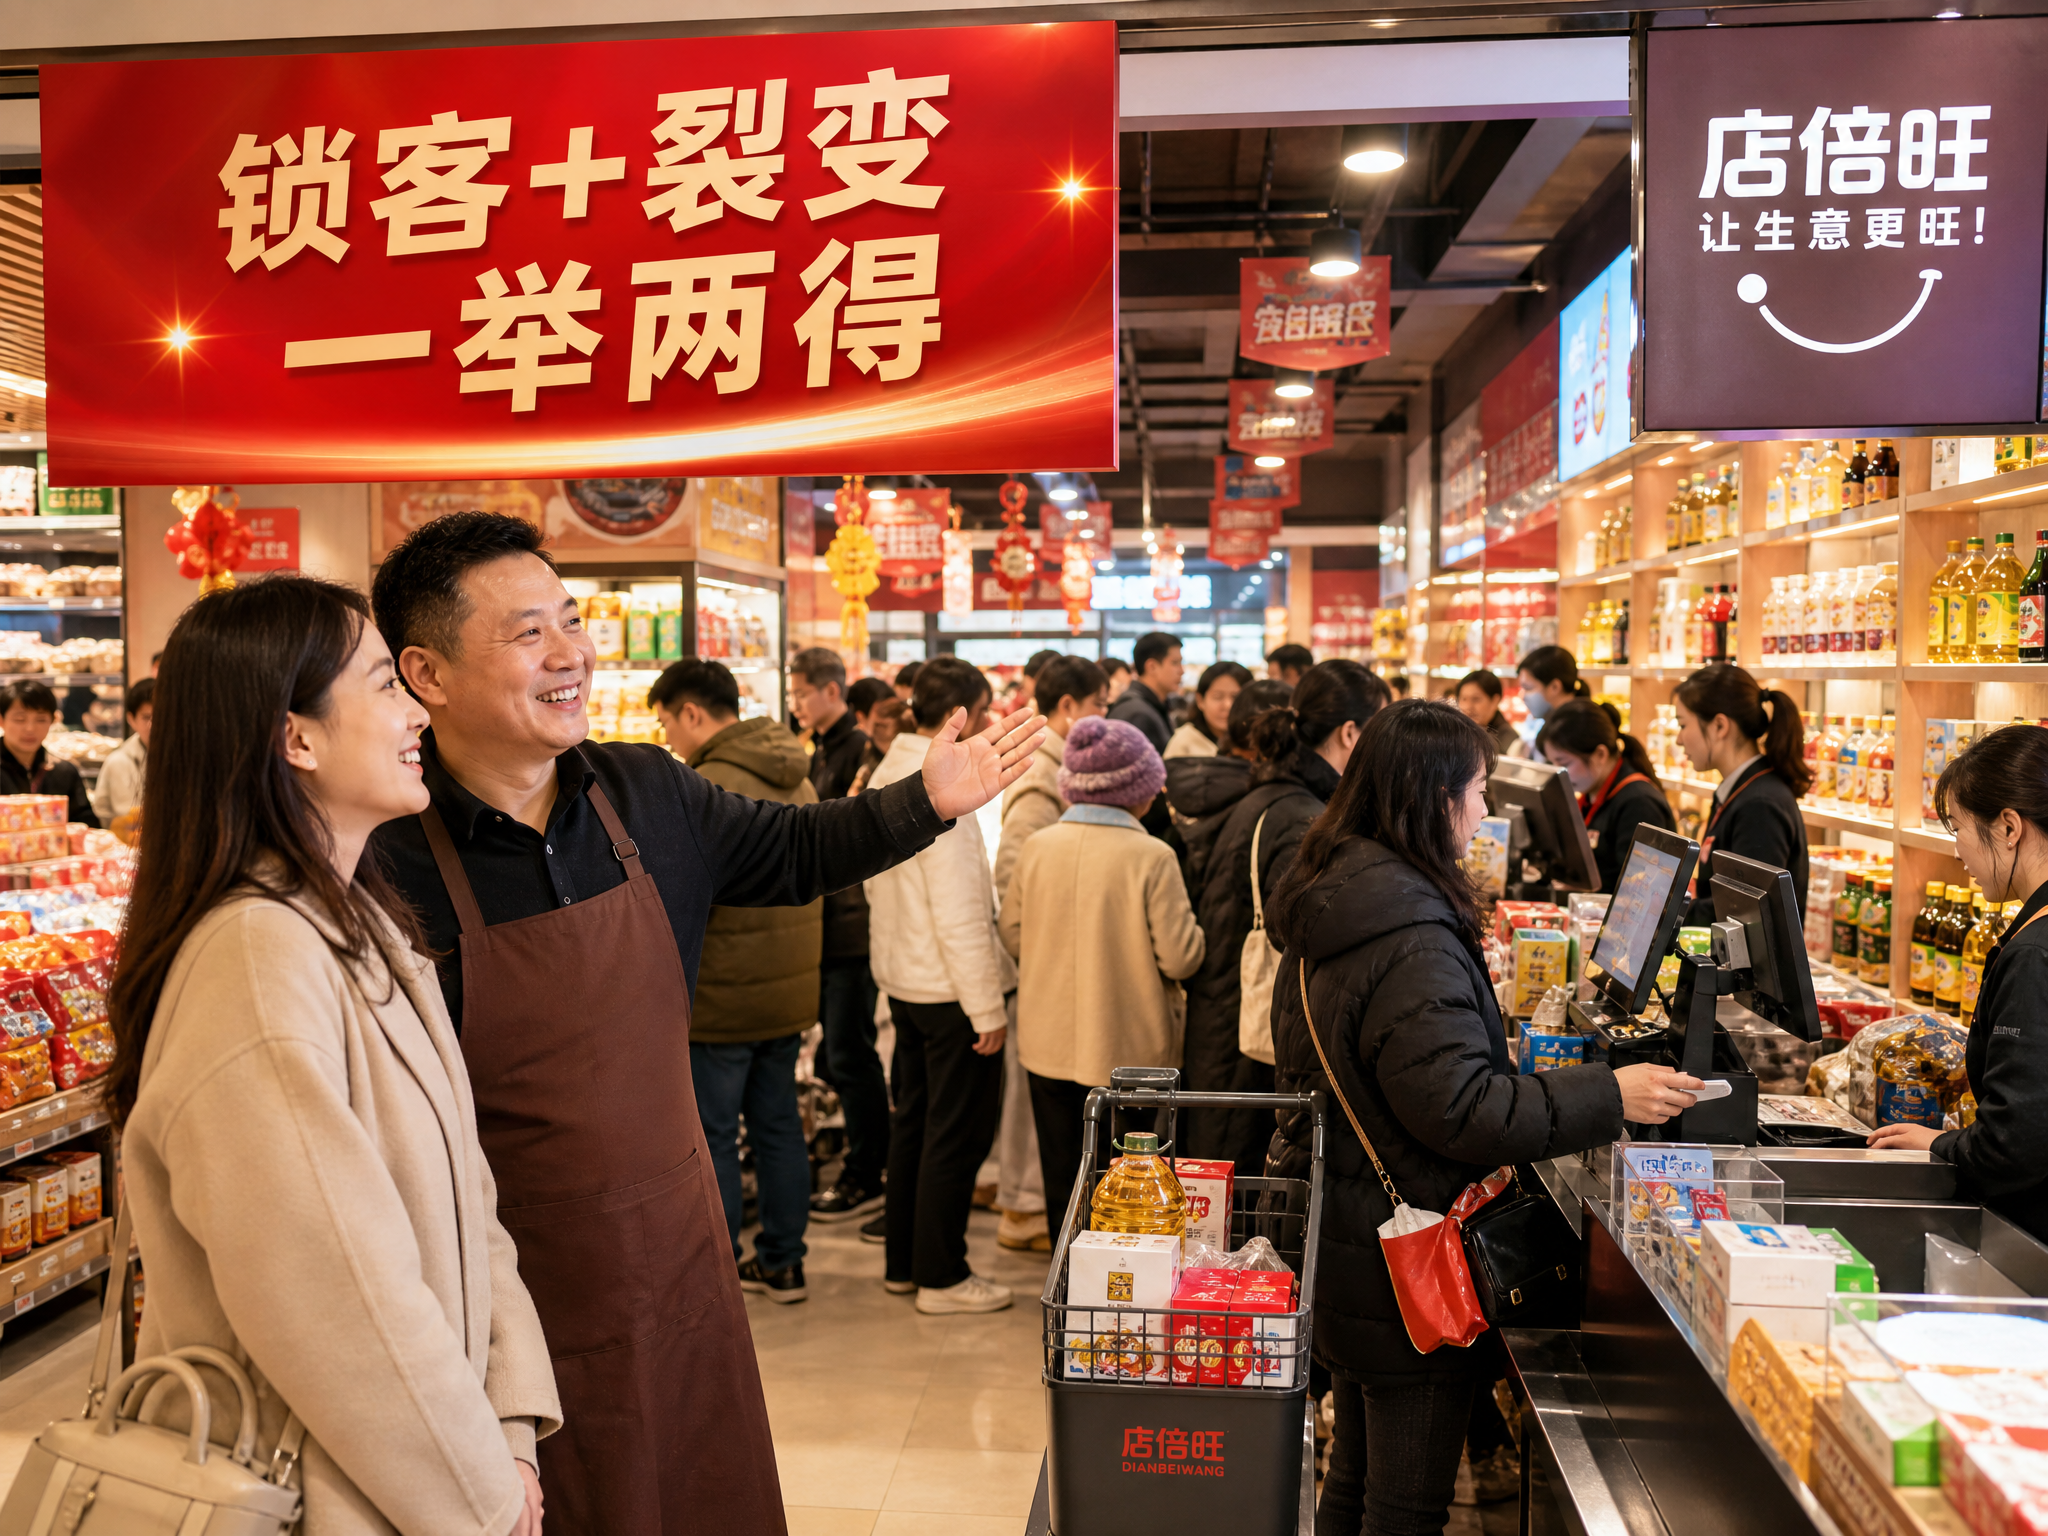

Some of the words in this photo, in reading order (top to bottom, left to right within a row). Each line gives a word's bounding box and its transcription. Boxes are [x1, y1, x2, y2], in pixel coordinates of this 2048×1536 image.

[217, 67, 950, 273] 锁客+裂变
[1698, 105, 1992, 199] 店倍旺
[283, 233, 942, 413] 一举两得
[1121, 1425, 1225, 1462] 店倍旺
[1121, 1461, 1225, 1477] DIANBEIWANG
